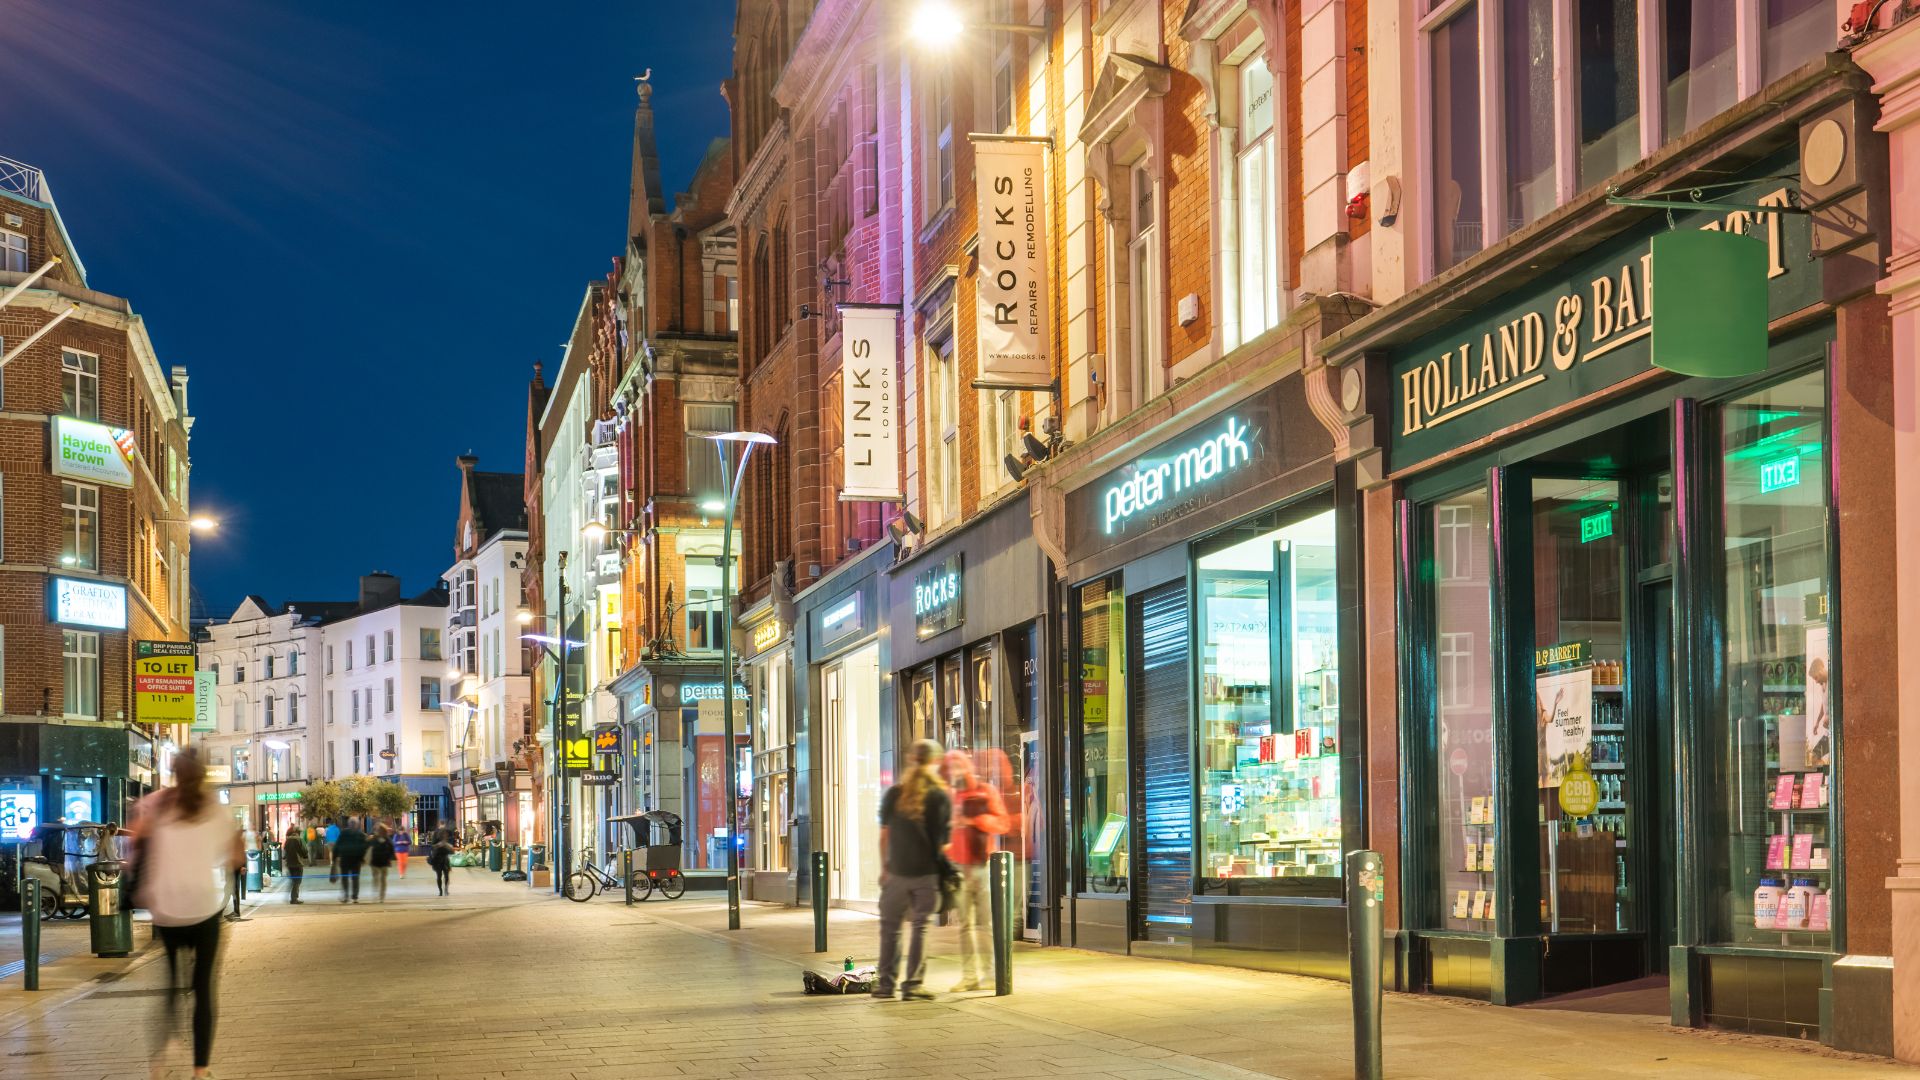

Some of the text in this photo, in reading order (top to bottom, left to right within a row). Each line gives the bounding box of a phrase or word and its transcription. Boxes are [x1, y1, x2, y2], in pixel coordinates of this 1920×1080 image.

[1024, 167, 1036, 259] REMODELLING
[994, 175, 1018, 325] ROCKS
[1030, 280, 1038, 335] REPAIRS
[988, 352, 1046, 361] www.rocks.ie
[1401, 311, 1544, 437] HOLLAND
[1552, 294, 1582, 372] &
[852, 338, 872, 466] LINKS
[881, 368, 889, 439] LONDON
[63, 433, 111, 454] Hayden
[63, 447, 104, 466] Brown
[1105, 416, 1249, 534] peter mark
[1585, 515, 1609, 537] EXIT
[73, 585, 118, 599] GRAFTON
[915, 573, 956, 615] ROCKS
[1549, 643, 1581, 661] BARRETT
[144, 662, 188, 674] TO LET
[196, 678, 210, 721] Dubray
[1555, 716, 1581, 727] summer
[1557, 708, 1569, 718] Feel
[1563, 725, 1585, 737] healthy
[1566, 781, 1590, 796] CBD
